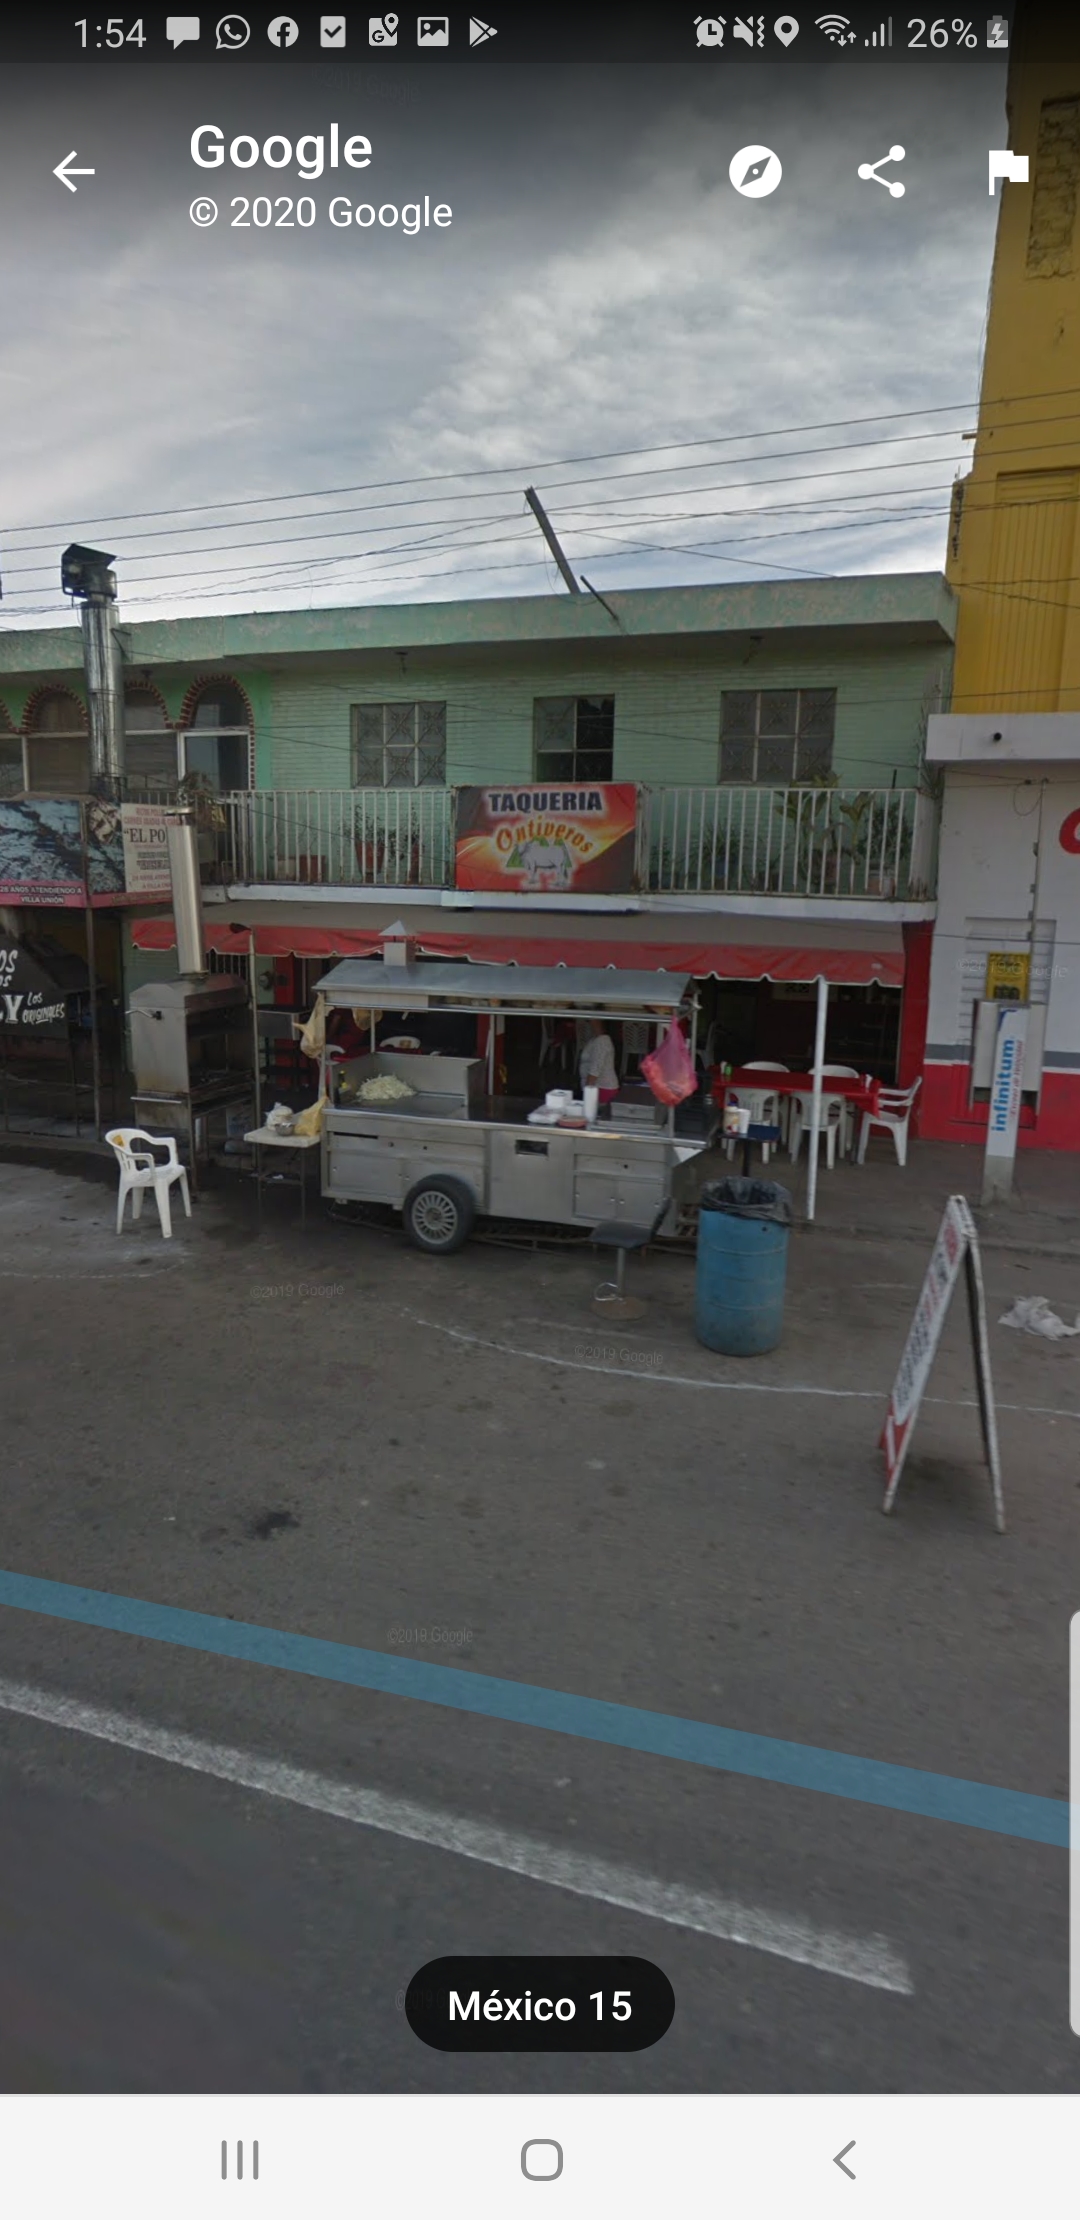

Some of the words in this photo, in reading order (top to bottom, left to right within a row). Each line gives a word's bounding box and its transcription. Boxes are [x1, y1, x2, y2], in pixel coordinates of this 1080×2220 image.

[488, 791, 603, 813] TAQUERIA
[149, 827, 167, 844] PO
[496, 815, 593, 853] Ontiveros
[11, 885, 29, 894] AÑOS
[31, 886, 75, 895] ATENDIENDO
[21, 896, 40, 904] VILLA
[42, 895, 64, 904] UNIÓN
[990, 1039, 1015, 1133] infinitum
